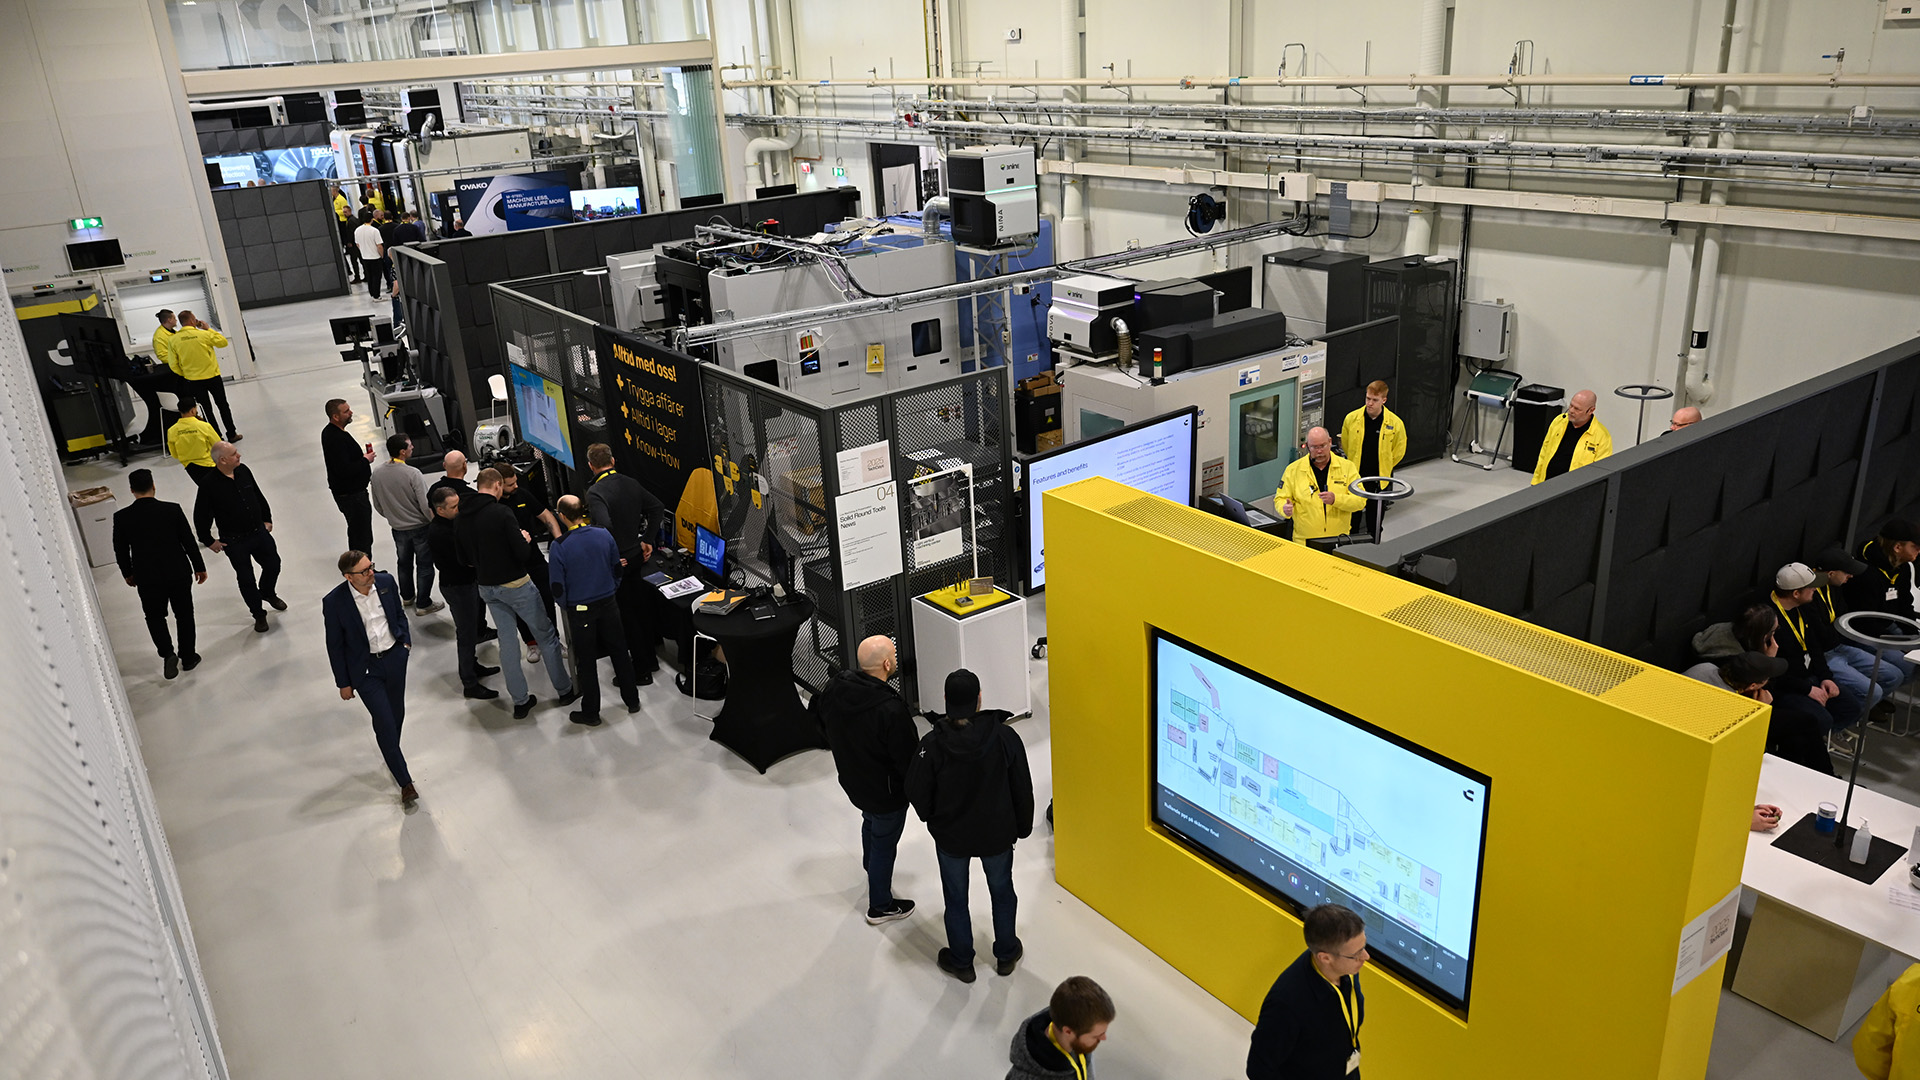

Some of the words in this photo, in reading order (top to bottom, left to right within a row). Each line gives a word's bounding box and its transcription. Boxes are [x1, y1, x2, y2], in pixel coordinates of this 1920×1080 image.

[460, 182, 488, 191] OVAKO
[506, 196, 533, 204] MACHINE
[507, 200, 549, 209] MANUFACTURE
[549, 197, 565, 205] MORE
[612, 343, 635, 366] Alltid
[635, 355, 656, 375] med
[657, 363, 677, 383] oss!
[626, 378, 654, 408] Trygga
[655, 392, 684, 418] affärer
[631, 407, 650, 430] Alltid
[655, 418, 677, 443] lager
[635, 434, 680, 470] Know-How
[867, 456, 884, 467] 2025
[1032, 472, 1057, 486] Features
[1057, 469, 1067, 479] and
[1067, 462, 1089, 475] benefits
[876, 484, 894, 501] 04
[839, 514, 854, 523] Solid
[854, 509, 872, 518] Round
[872, 505, 886, 513] Tools
[840, 521, 856, 529] News
